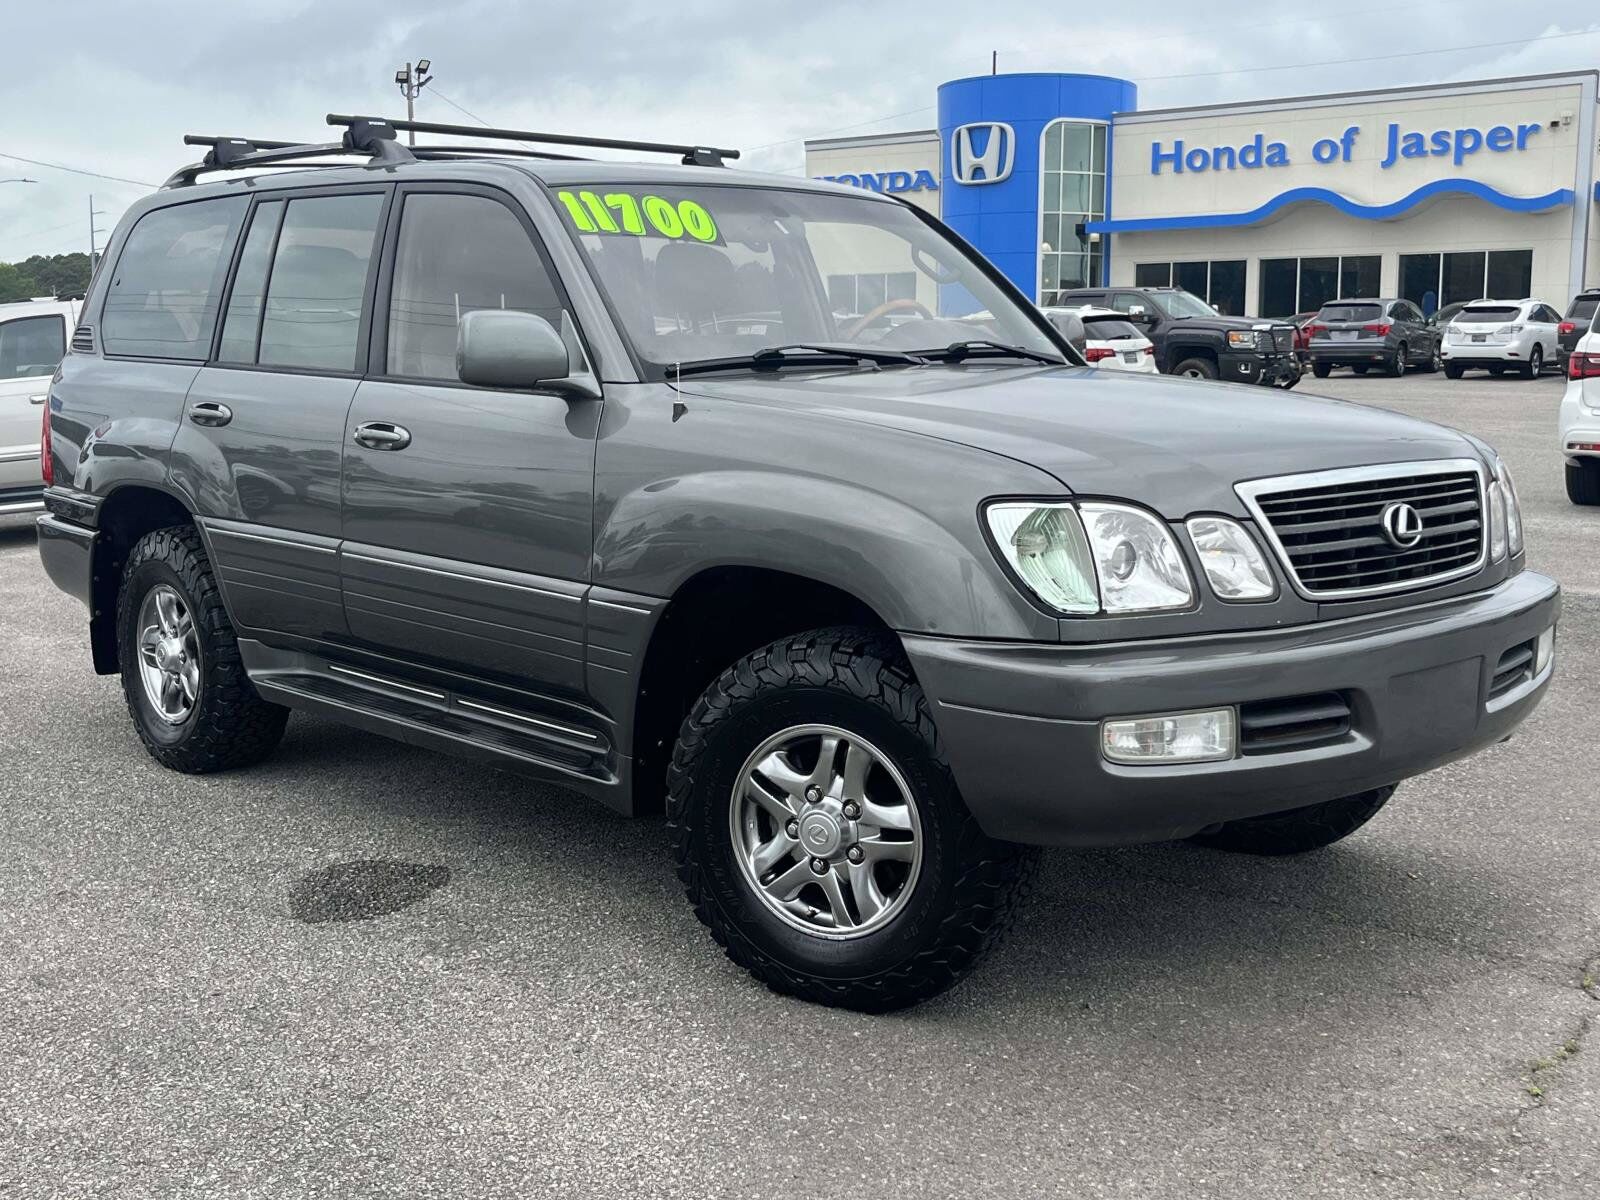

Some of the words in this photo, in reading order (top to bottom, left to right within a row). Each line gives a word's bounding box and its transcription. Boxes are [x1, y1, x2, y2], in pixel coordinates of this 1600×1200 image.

[1150, 133, 1290, 175] Honda
[1312, 126, 1361, 164] of
[1380, 123, 1542, 169] Jasper
[813, 170, 939, 194] ONDA
[558, 191, 718, 243] 11700
